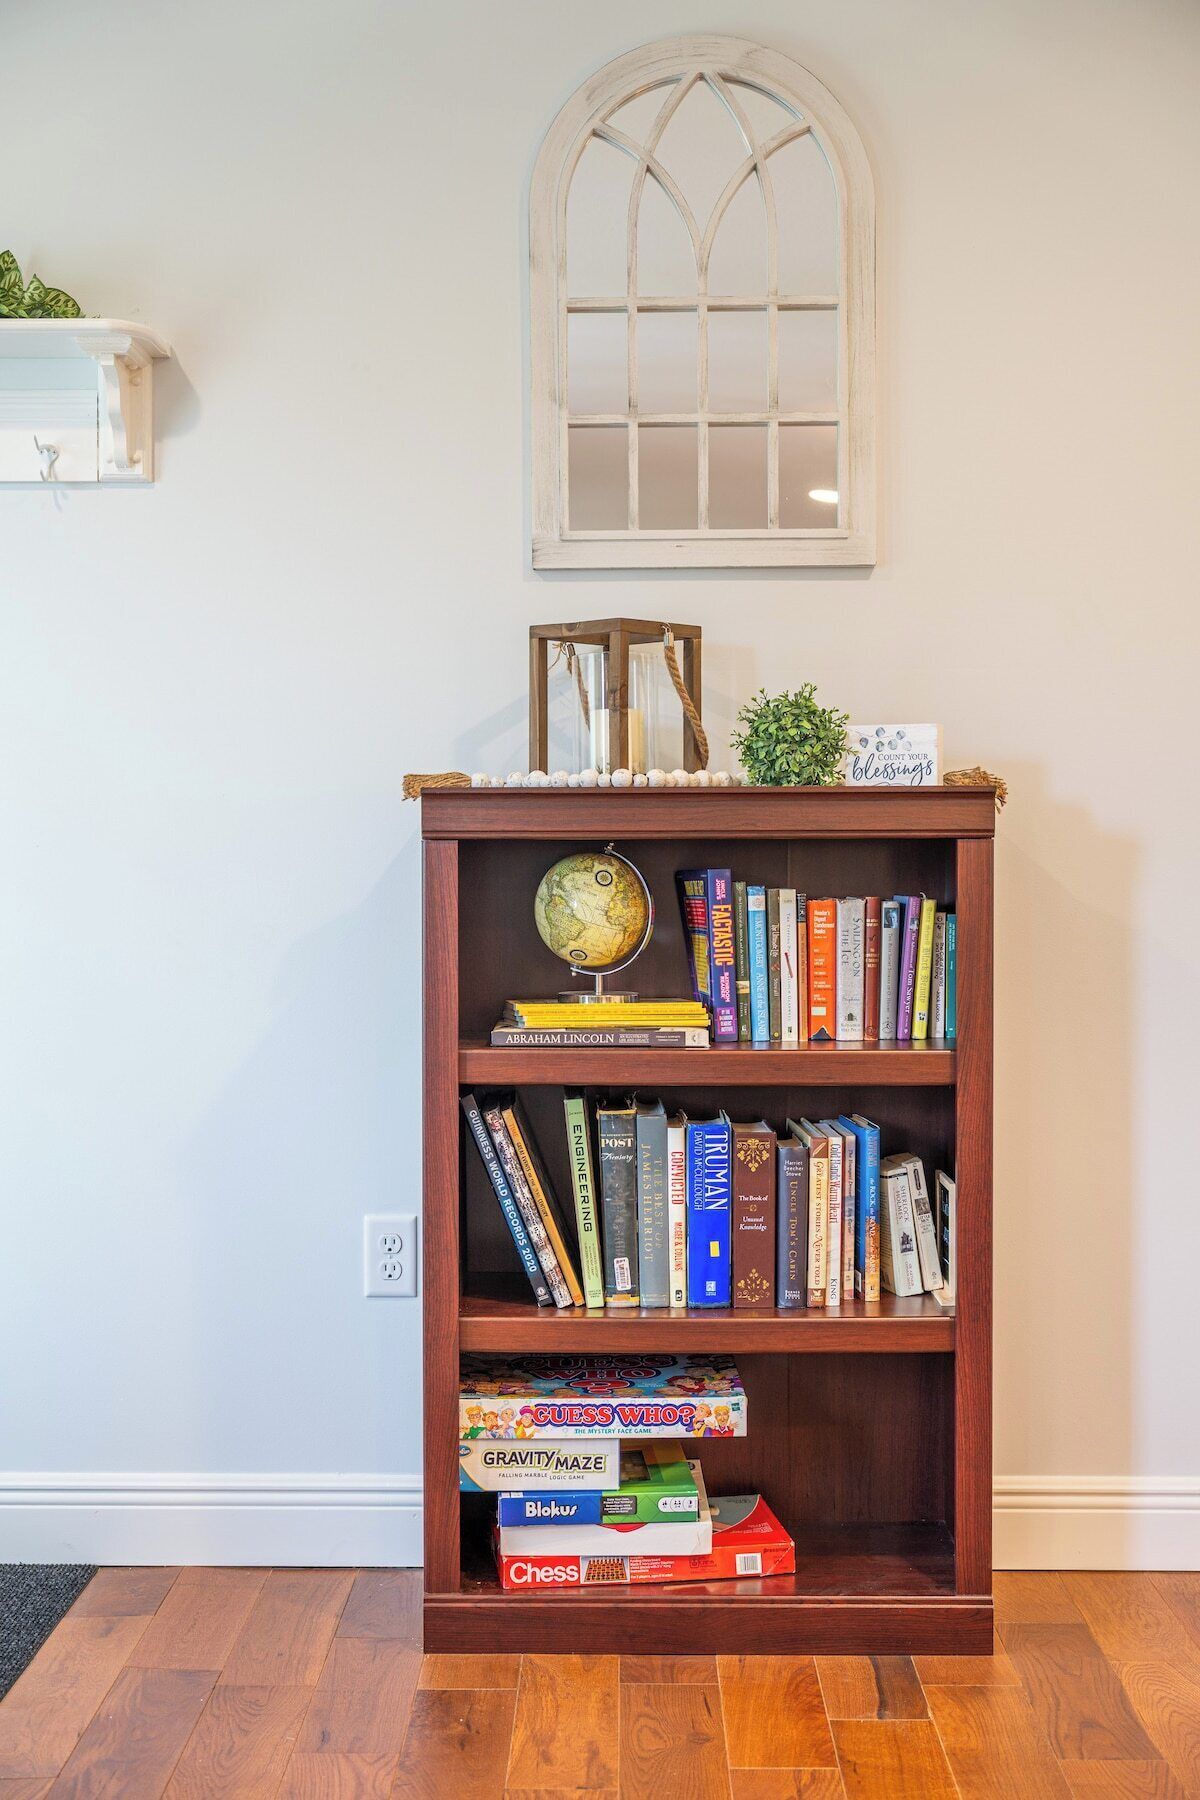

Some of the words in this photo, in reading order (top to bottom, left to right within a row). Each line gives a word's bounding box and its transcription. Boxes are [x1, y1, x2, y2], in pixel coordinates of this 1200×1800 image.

[852, 753, 934, 786] blessings
[878, 753, 905, 761] COUNT
[712, 904, 735, 966] FACTASTIC
[755, 920, 764, 968] MONTGOMERY
[841, 929, 849, 946] THE
[852, 916, 863, 959] SAILING
[841, 950, 851, 966] ICE
[852, 961, 861, 977] ON
[723, 972, 731, 1003] BATHROOM
[757, 973, 766, 992] ANNE
[907, 969, 915, 986] Tom
[903, 987, 913, 1013] Sawyer
[757, 1009, 767, 1035] ISLAND
[506, 1032, 561, 1044] ABRAHAM
[564, 1031, 614, 1043] LINCOLN
[601, 1138, 633, 1148] POST
[694, 1131, 703, 1156] DAVID
[830, 1144, 840, 1159] Cold
[601, 1152, 633, 1163] Treasury
[641, 1144, 651, 1190] JAMES
[830, 1159, 840, 1180] Hands
[572, 1124, 592, 1233] ENGINEERING
[653, 1157, 662, 1187] THE
[671, 1151, 685, 1206] CONVICTED
[704, 1131, 728, 1211] TRUMAN
[814, 1161, 824, 1200] GREATEST
[469, 1109, 494, 1160] GUINNESS
[489, 1160, 508, 1197] WORLD
[503, 1199, 527, 1246] RECORDS
[522, 1248, 537, 1272] 2020
[789, 1180, 798, 1213] UNCLE
[829, 1180, 840, 1202] Warm
[900, 1185, 909, 1222] SHERLOCK
[654, 1193, 664, 1228] BEST
[829, 1202, 840, 1224] Heart
[895, 1190, 904, 1220] HOLMES
[643, 1196, 653, 1263] HERRIOT
[655, 1232, 664, 1249] OF
[789, 1217, 798, 1246] TOM'S
[674, 1248, 683, 1272] COLLINS
[812, 1234, 823, 1263] NEVER
[789, 1250, 797, 1281] CABIN
[529, 1367, 658, 1379] WHO
[532, 1406, 613, 1425] GUESS
[617, 1405, 696, 1424] WHO?
[483, 1451, 556, 1467] GRAVITY
[554, 1456, 604, 1470] MAZE
[525, 1501, 578, 1518] Blokus
[509, 1562, 579, 1584] Chess
